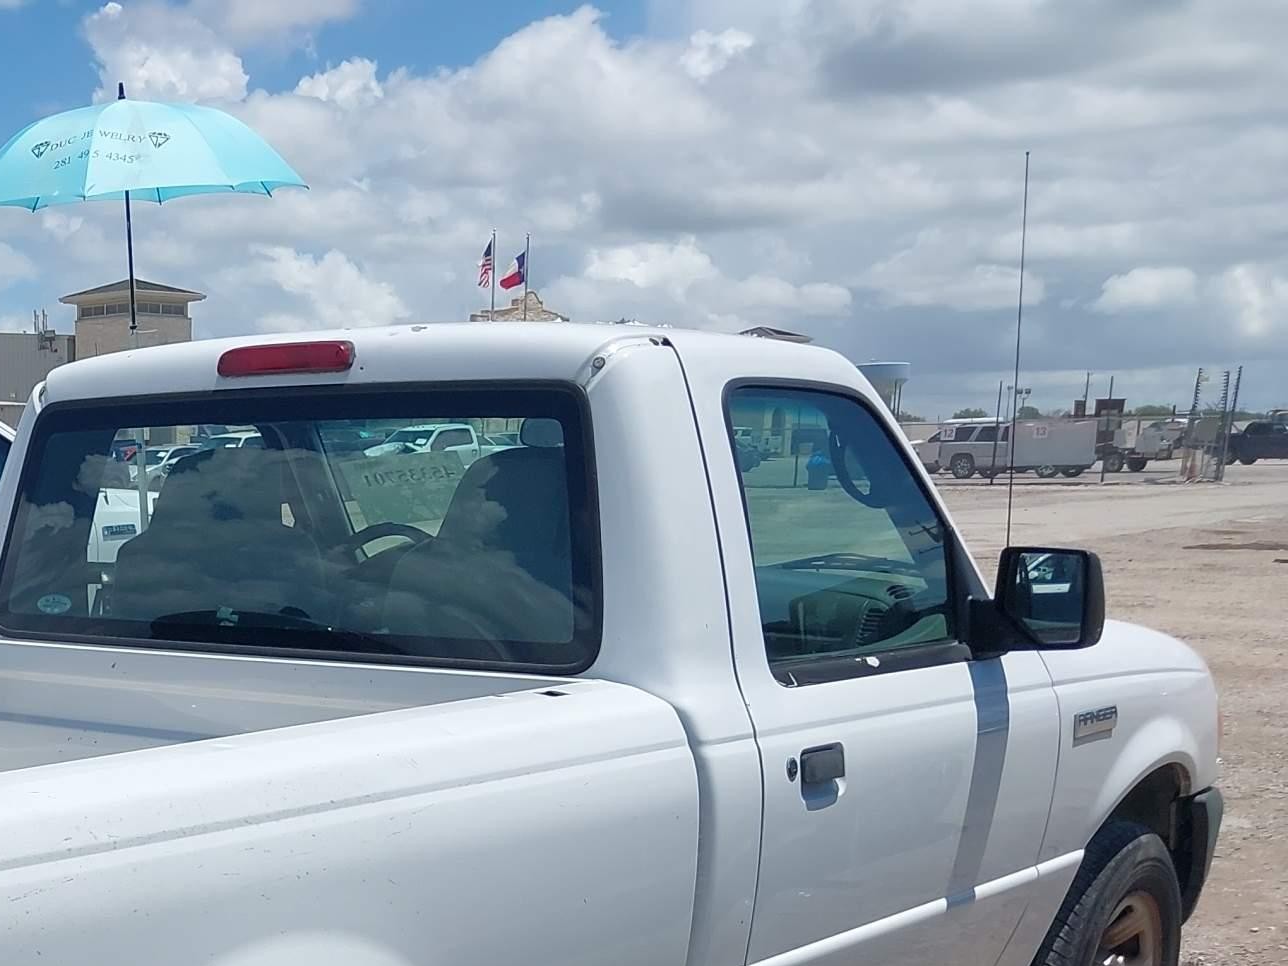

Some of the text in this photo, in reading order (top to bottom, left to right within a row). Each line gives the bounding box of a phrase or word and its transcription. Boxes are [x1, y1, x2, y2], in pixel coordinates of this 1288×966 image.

[50, 136, 77, 151] DUC
[53, 156, 71, 170] 281
[1036, 426, 1048, 437] 13
[1078, 705, 1118, 728] RANGER
